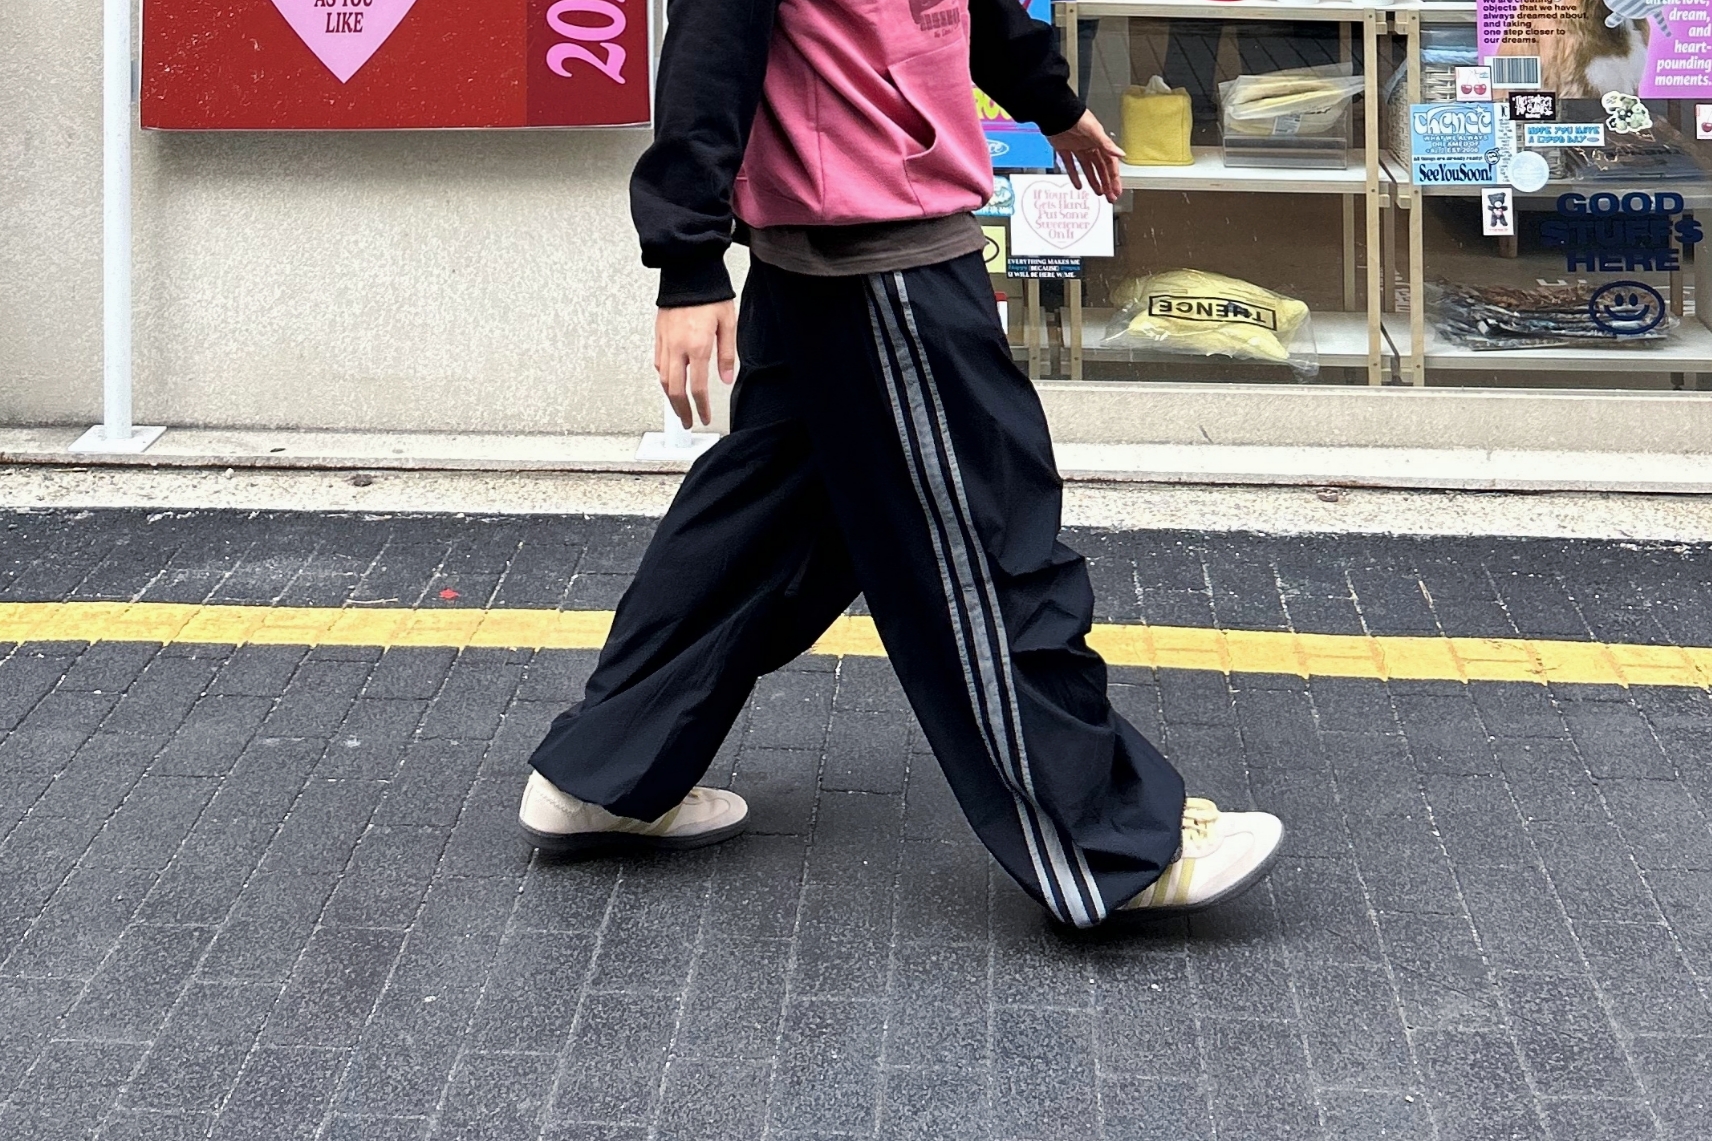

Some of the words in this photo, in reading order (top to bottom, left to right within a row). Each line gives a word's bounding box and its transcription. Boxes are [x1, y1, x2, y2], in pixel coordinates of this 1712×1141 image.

[1669, 7, 1710, 22] dream,
[326, 13, 364, 34] LIKE
[1689, 23, 1712, 37] and
[1674, 40, 1712, 53] heart-
[1656, 56, 1712, 73] pounding
[1655, 74, 1712, 85] moments.
[1034, 190, 1041, 199] If
[1045, 190, 1068, 199] Your
[1070, 190, 1089, 199] Life
[1034, 200, 1056, 210] Gets
[1059, 200, 1090, 210] Hard,
[1556, 192, 1684, 217] GOOD
[1038, 210, 1057, 219] Put
[1059, 211, 1088, 219] Some
[1036, 221, 1090, 229] Sweetener
[1049, 229, 1065, 238] On
[1066, 229, 1074, 238] It
[1566, 249, 1680, 272] HERE
